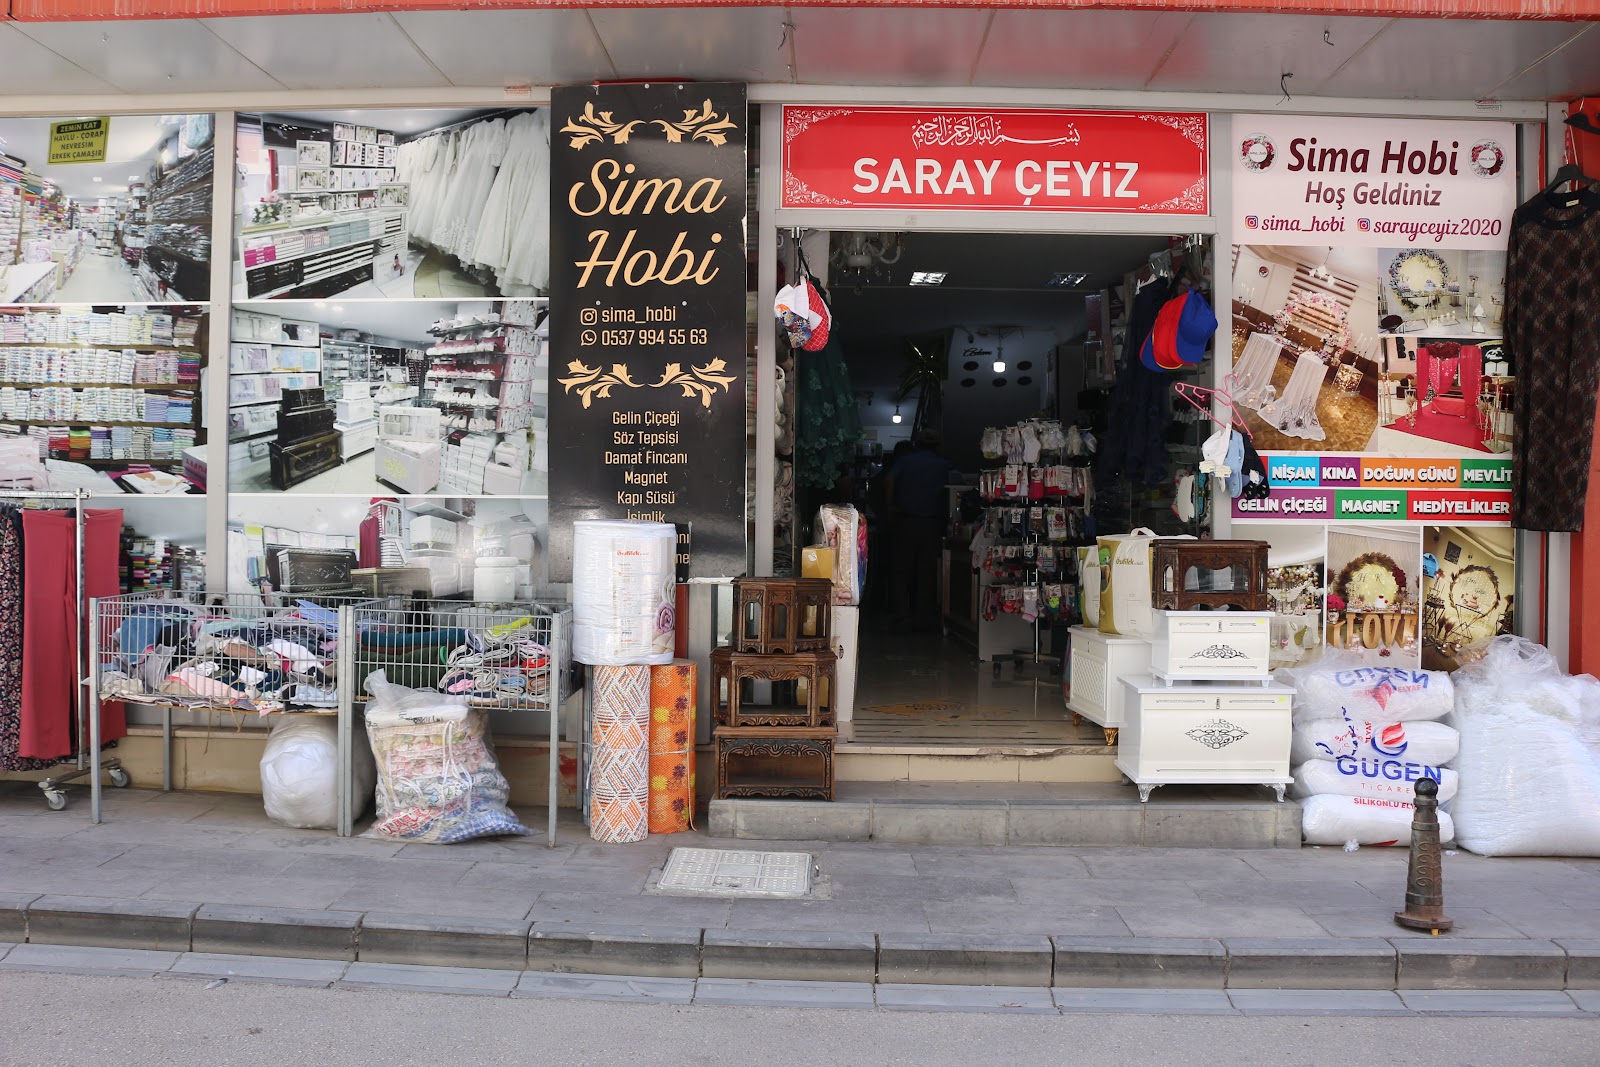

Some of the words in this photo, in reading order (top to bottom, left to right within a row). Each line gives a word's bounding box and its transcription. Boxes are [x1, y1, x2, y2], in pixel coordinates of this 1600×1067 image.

[83, 121, 98, 130] KAT
[53, 134, 75, 142] HAVLU
[80, 130, 104, 140] ÇORAP
[51, 152, 71, 160] ERKEK
[1287, 137, 1370, 174] Sima
[1381, 140, 1459, 176] Hobi
[852, 157, 1001, 196] SARAY
[568, 158, 727, 217] Sima
[1305, 181, 1346, 210] Hoş
[1353, 181, 1442, 207] Geldiniz
[1261, 215, 1346, 232] sima_hobi
[1373, 218, 1502, 243] sarayceyiz2020
[574, 229, 722, 289] Hobi
[601, 306, 677, 324] sima_hobi
[601, 330, 636, 346] 0537
[638, 330, 665, 346] 994
[668, 330, 687, 345] 55
[689, 328, 708, 345] 63
[612, 411, 642, 425] Gelin
[644, 411, 681, 427] Çiçeği
[613, 430, 635, 445] Söz
[637, 431, 680, 446] Tepsisi
[605, 451, 643, 465] Damat
[646, 451, 688, 465] Fincanı
[624, 471, 668, 487] Magnet
[1272, 465, 1316, 482] NİŞAN
[1322, 467, 1357, 481] KINA
[1363, 465, 1415, 482] DOĞUM
[1417, 466, 1457, 482] GÜNÜ
[1463, 467, 1512, 483] MEVLİT
[617, 491, 643, 506] Kapı
[646, 491, 675, 504] Süsü
[1237, 498, 1279, 513] GELİN
[1281, 496, 1327, 514] ÇİÇEĞİ
[1413, 498, 1510, 514] HEDİYELİKLER
[1341, 500, 1400, 514] MAGNET
[1336, 755, 1442, 785] GÜGEN
[1353, 797, 1400, 808] SİLİKONLU
